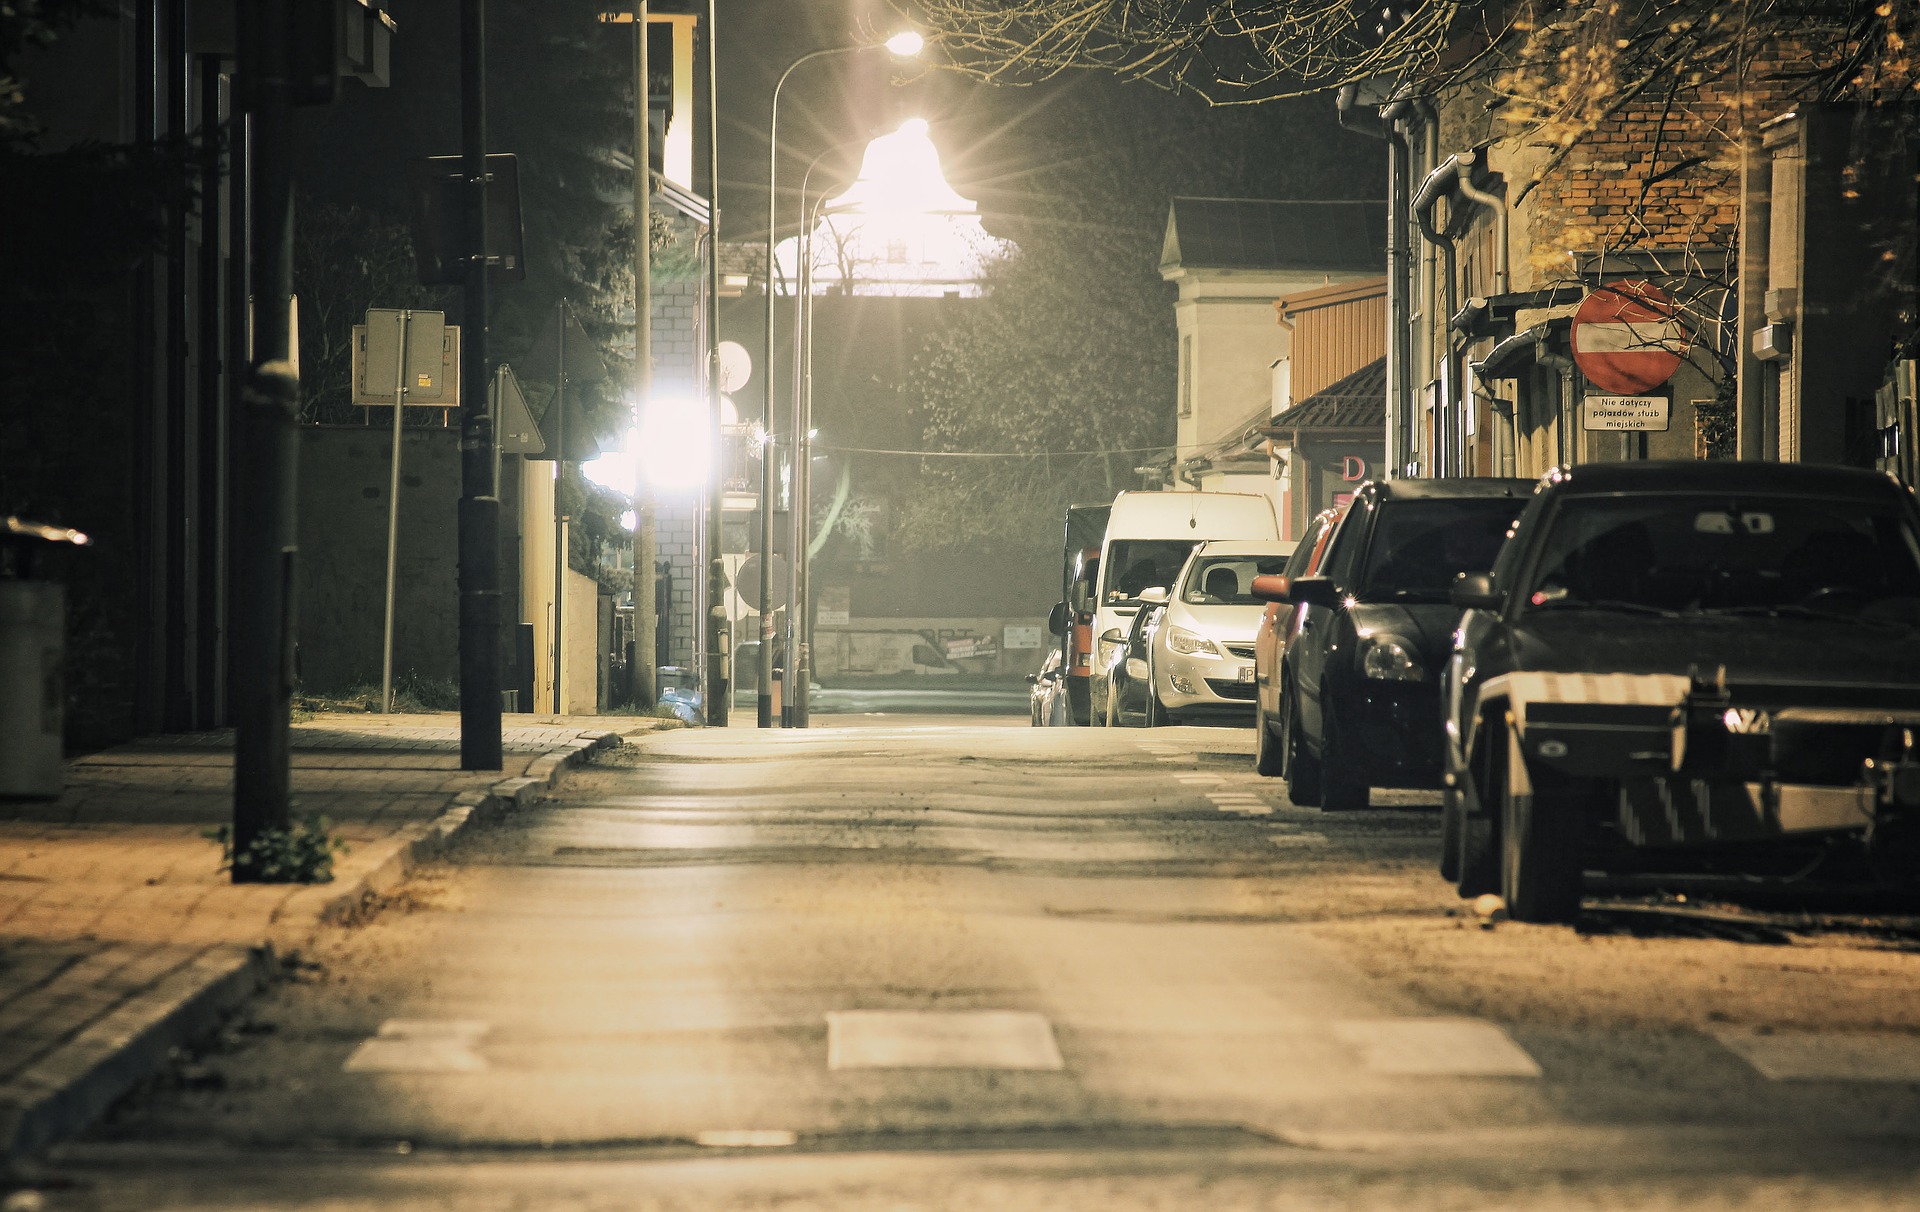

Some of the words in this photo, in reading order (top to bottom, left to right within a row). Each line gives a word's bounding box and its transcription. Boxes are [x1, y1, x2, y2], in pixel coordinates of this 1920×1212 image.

[1601, 398, 1616, 406] Nie
[1620, 398, 1651, 407] dotyczy
[1593, 409, 1634, 418] pojazdów
[1637, 409, 1660, 417] służb
[1606, 420, 1645, 428] miejskich
[1343, 456, 1365, 480] D
